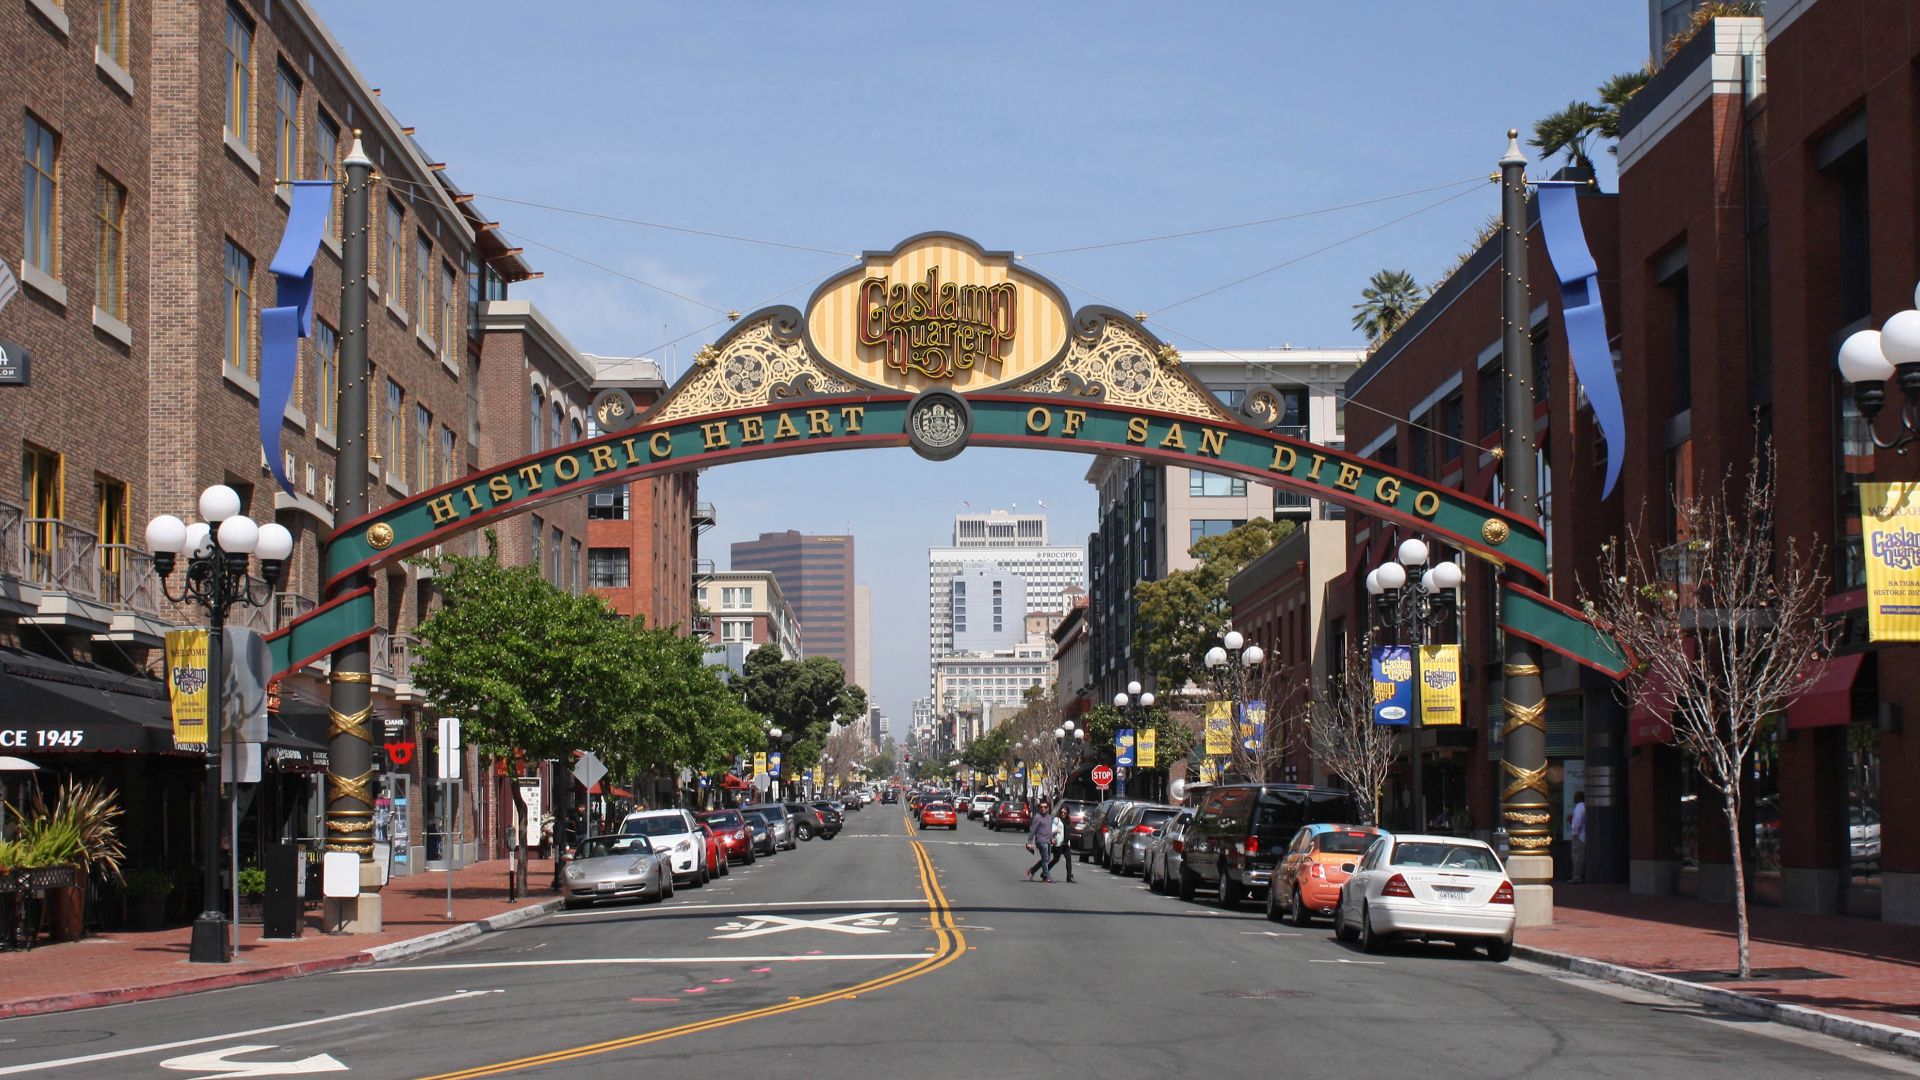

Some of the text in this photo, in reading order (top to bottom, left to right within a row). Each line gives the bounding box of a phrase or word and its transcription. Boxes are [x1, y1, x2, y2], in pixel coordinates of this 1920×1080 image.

[859, 265, 1018, 365] Gaslamp
[886, 322, 994, 379] Quarter
[426, 431, 673, 524] HISTORIC
[701, 406, 865, 448] HEART
[1026, 406, 1087, 434] OF
[1126, 417, 1229, 456] SAN
[1269, 444, 1441, 516] DIEGO
[171, 647, 207, 657] WELCOME
[173, 663, 207, 686] Gaslamp
[1424, 667, 1457, 684] Gaslamp
[36, 729, 84, 747] 1945
[1093, 771, 1111, 779] STOP
